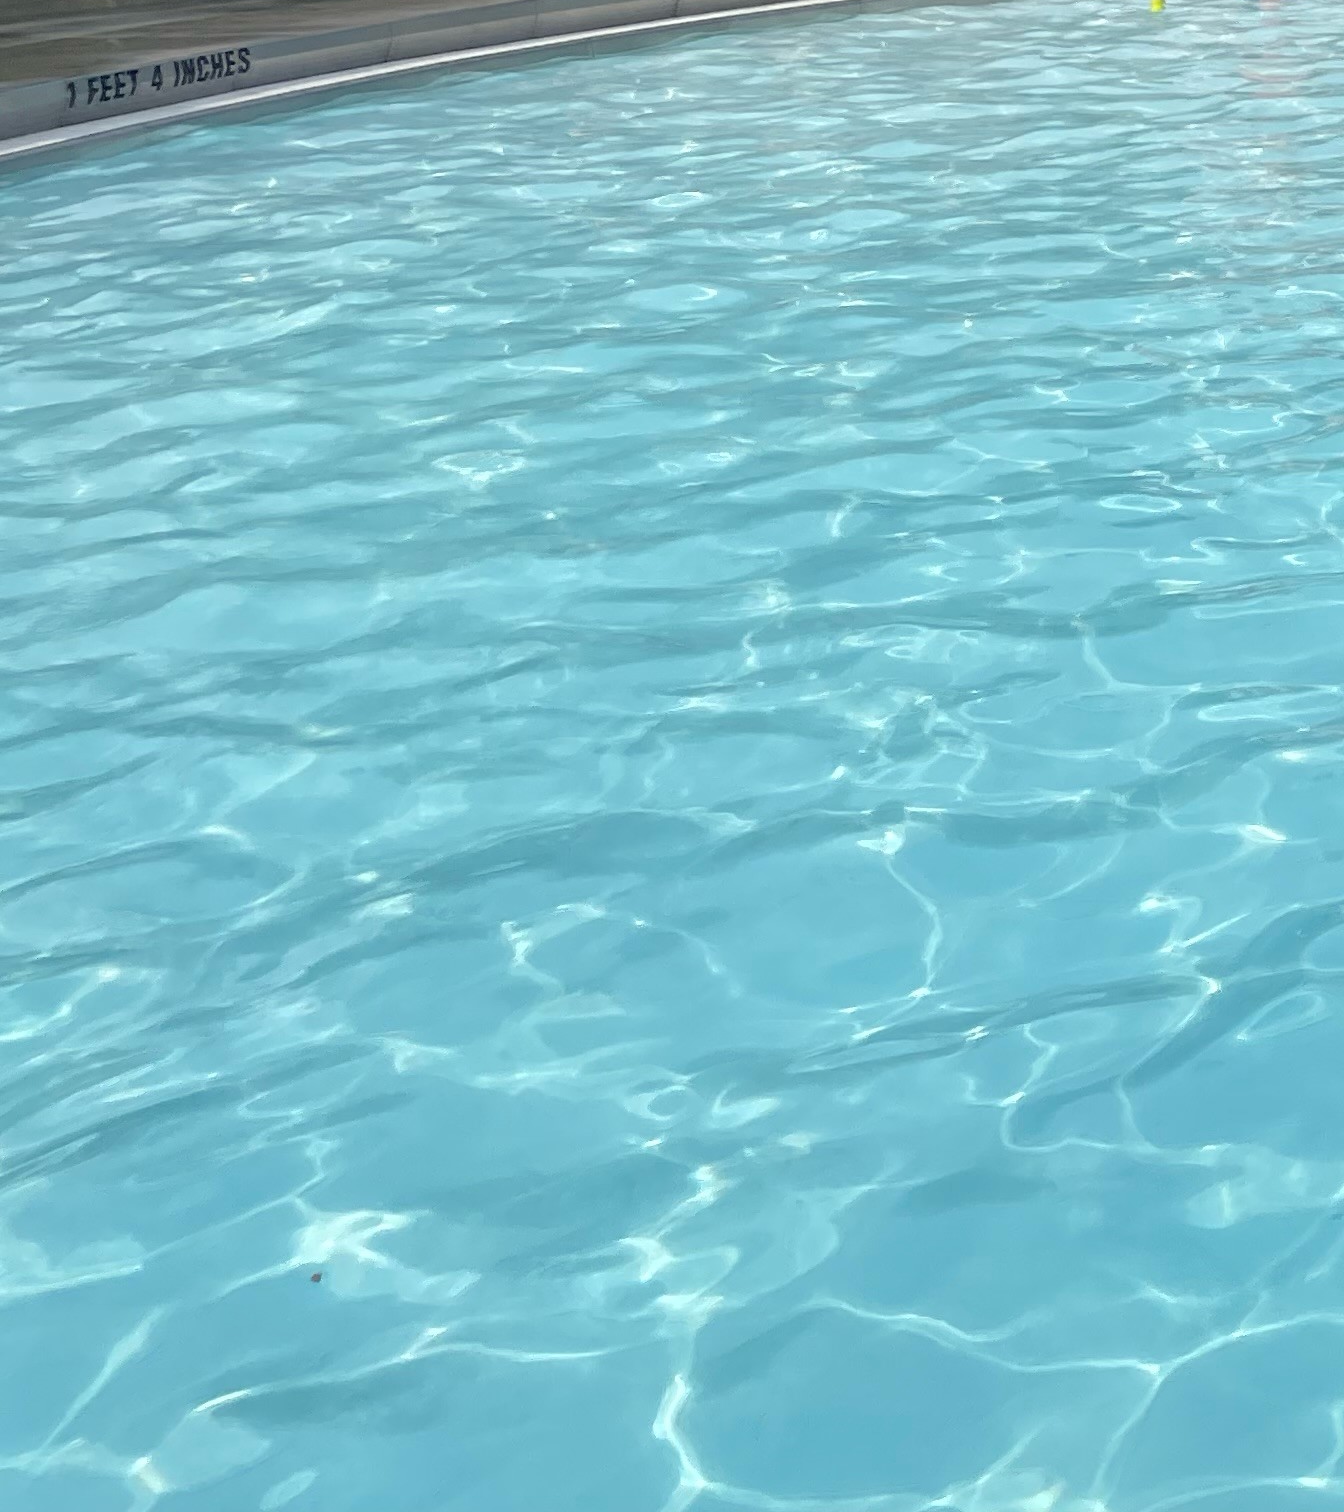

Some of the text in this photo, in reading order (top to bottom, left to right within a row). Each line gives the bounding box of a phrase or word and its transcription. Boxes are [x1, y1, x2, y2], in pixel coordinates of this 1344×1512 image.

[87, 69, 139, 105] FEET
[151, 65, 164, 91] 4
[173, 47, 252, 88] INCHES
